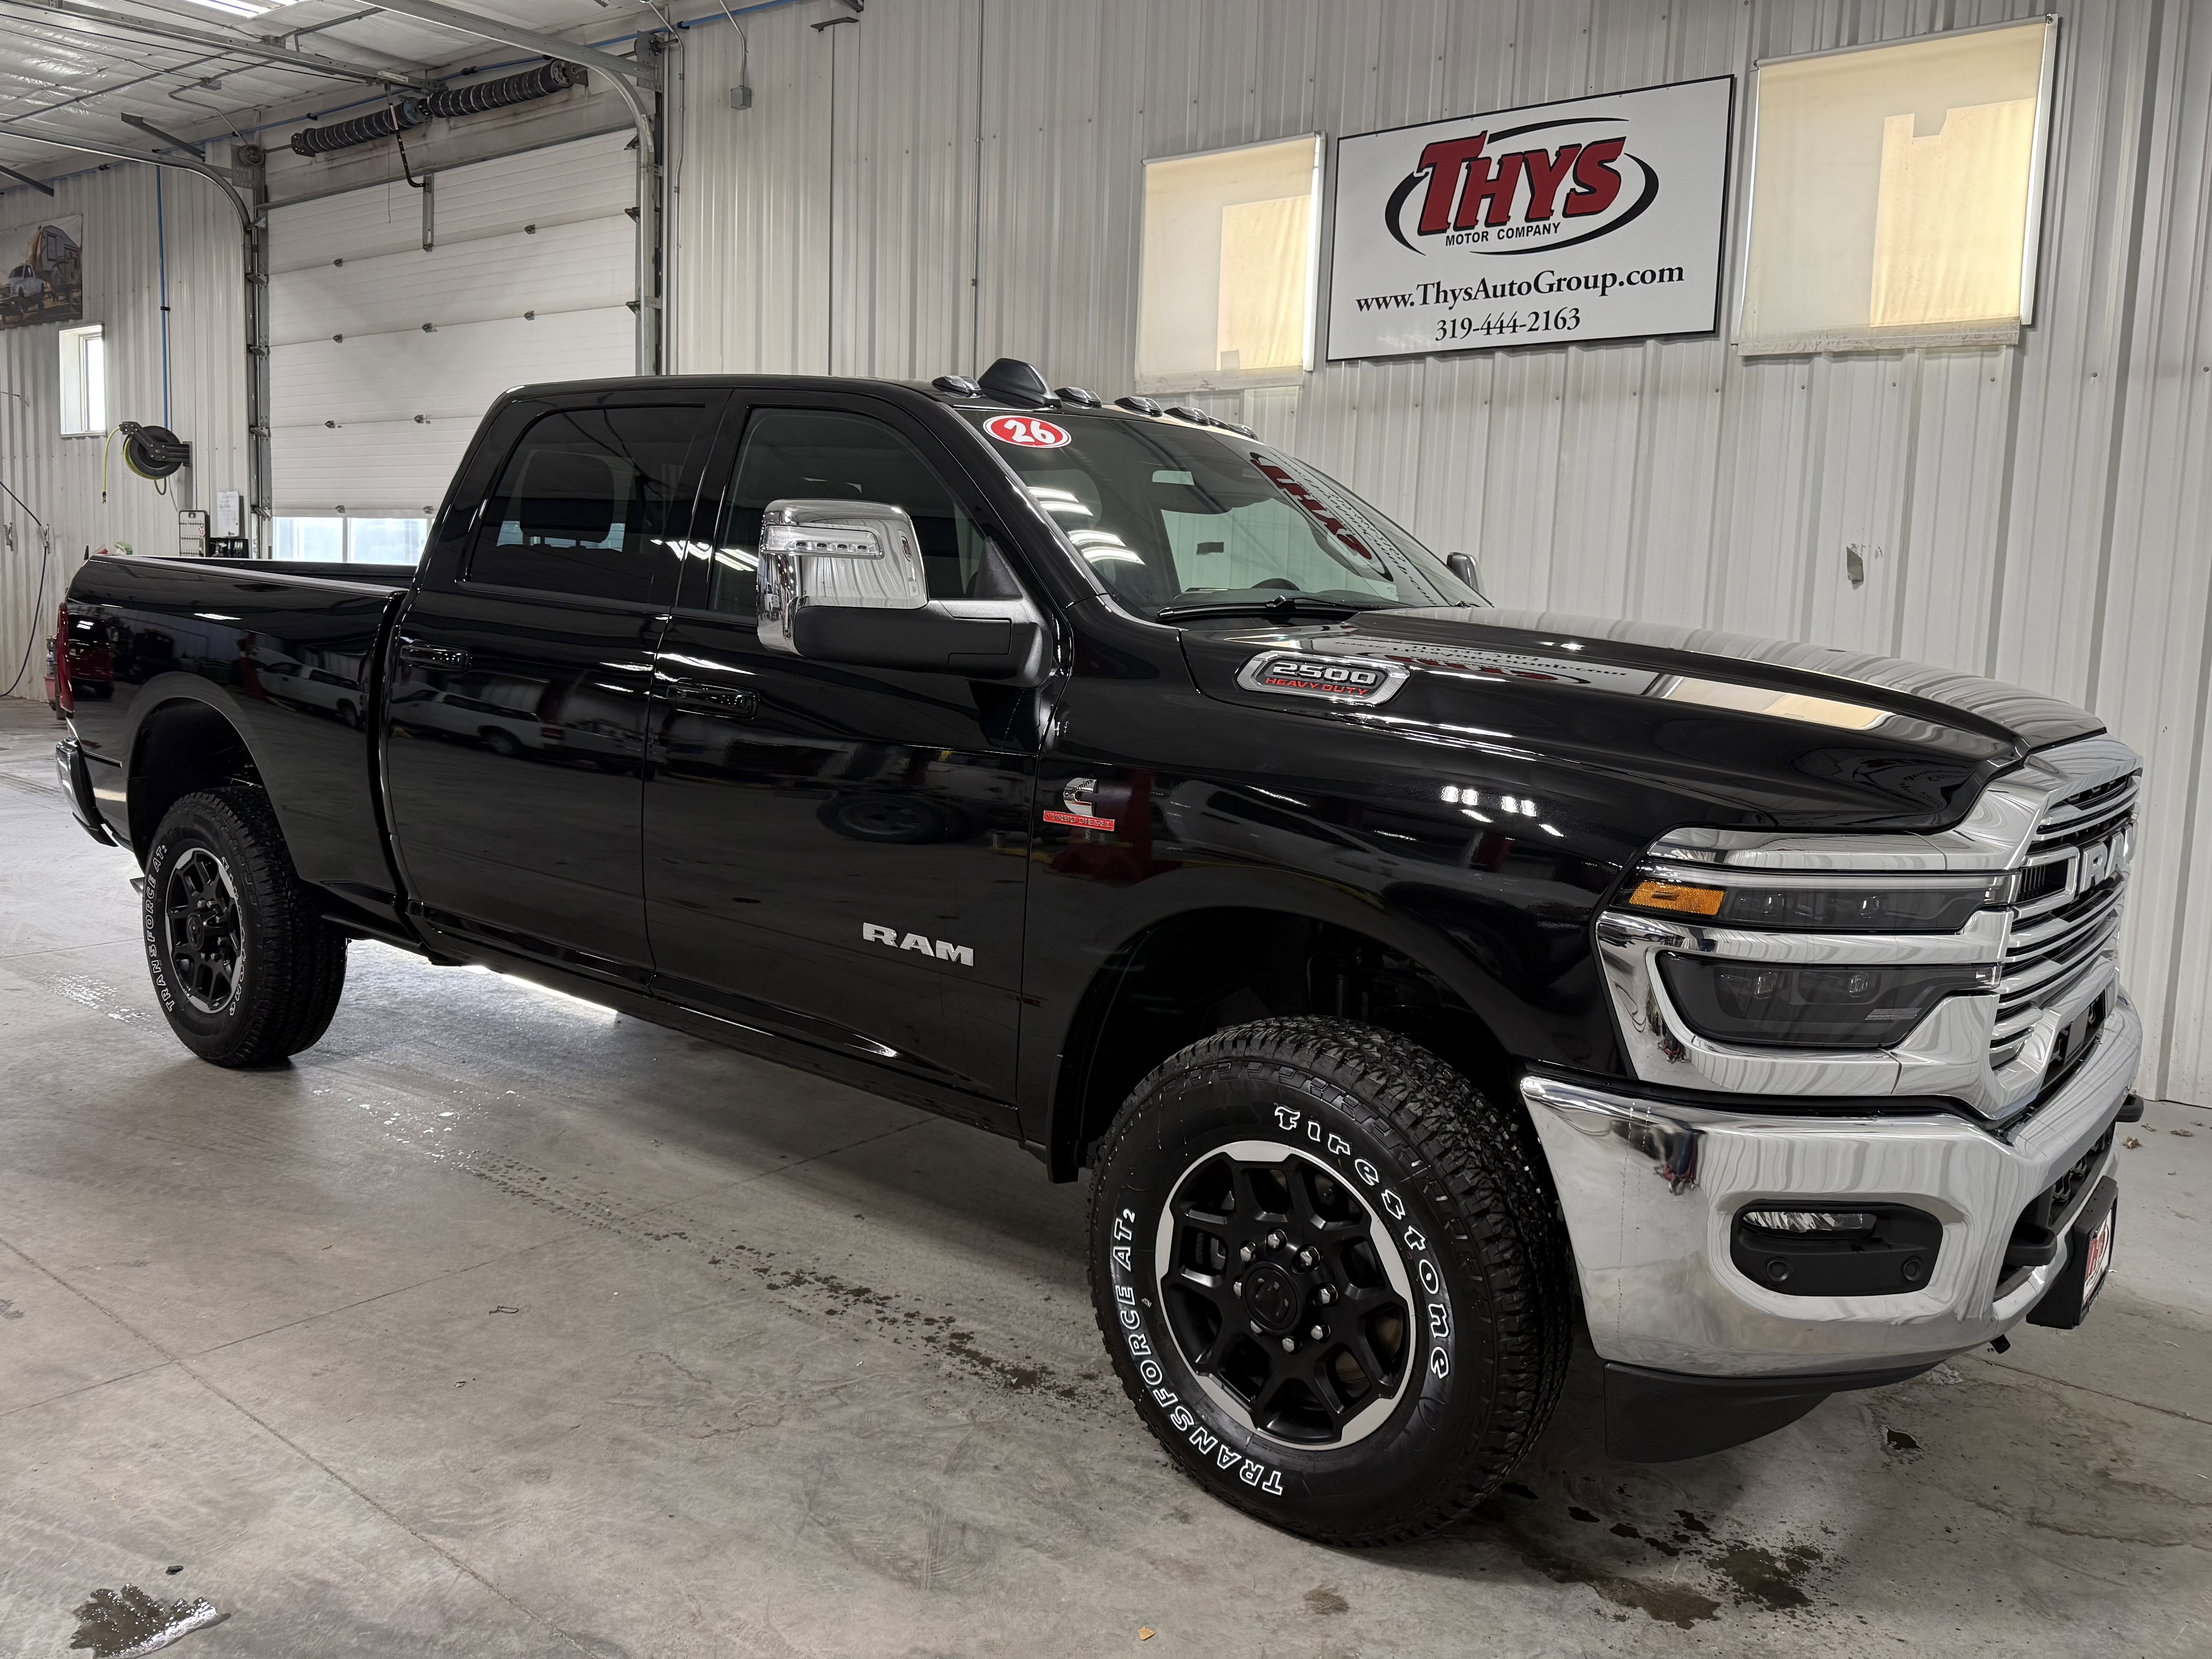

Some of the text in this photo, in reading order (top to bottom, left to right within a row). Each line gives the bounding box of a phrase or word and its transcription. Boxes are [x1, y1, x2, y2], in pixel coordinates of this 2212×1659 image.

[1416, 130, 1626, 236] THYS
[1446, 222, 1561, 247] MOTOR COMPANY
[1355, 265, 1684, 312] www.ThysAutoGroup.com
[1435, 306, 1580, 342] 319-444-2163
[1004, 420, 1055, 443] 26
[1265, 677, 1370, 696] HEAVY DUTY
[1273, 661, 1376, 685] 2500
[1064, 779, 1093, 798] Cummins
[1046, 813, 1112, 829] TURBO DIESEL
[146, 874, 175, 1012] TRANSFORCE
[863, 922, 974, 967] RAM
[1274, 1106, 1449, 1379] Firestone
[1115, 1285, 1284, 1496] TRANSFORCE
